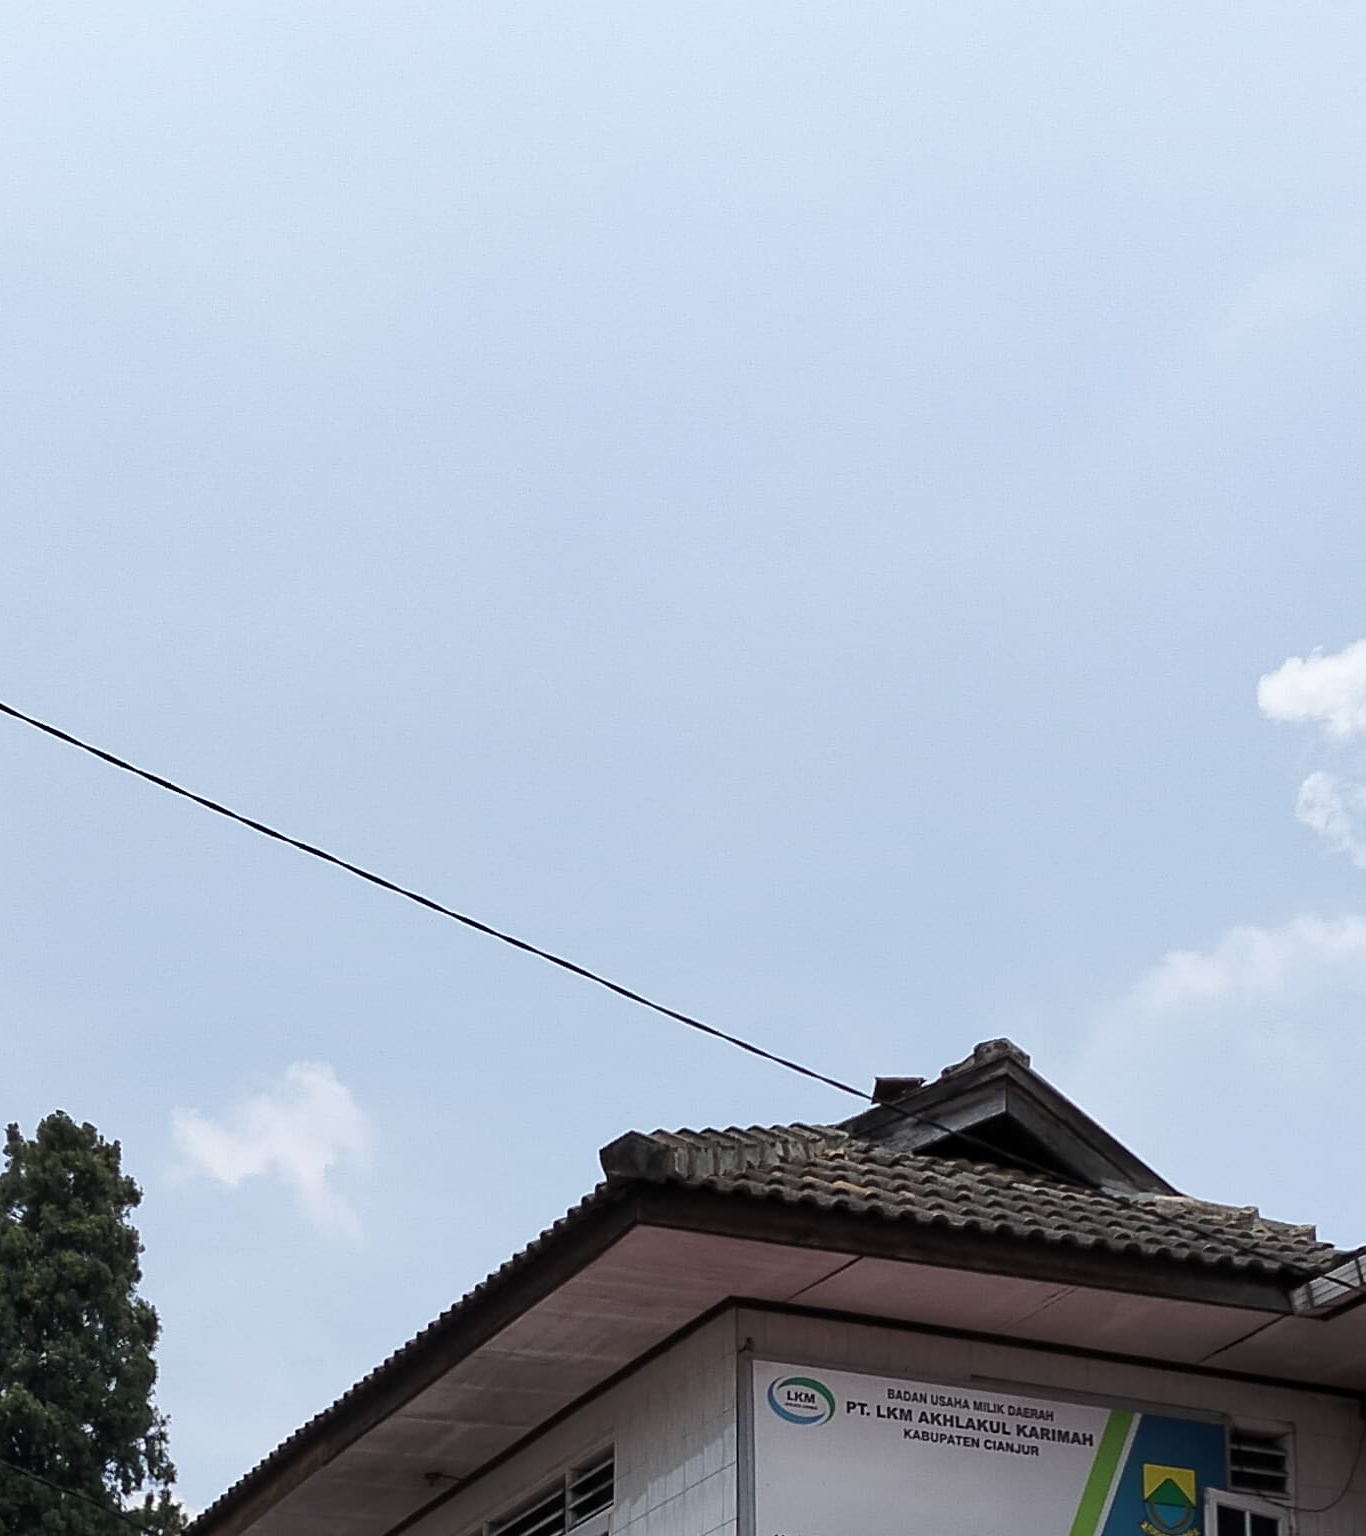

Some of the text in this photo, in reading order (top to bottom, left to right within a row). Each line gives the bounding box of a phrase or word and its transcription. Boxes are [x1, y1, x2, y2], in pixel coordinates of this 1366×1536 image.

[787, 1390, 816, 1404] LKM
[887, 1388, 1054, 1421] BADAN USAHA MILIK DAERAH
[846, 1401, 1094, 1447] PT. LKM AKHLAKUL KARIMAH
[903, 1428, 1039, 1457] KABUPATEN CIANJUR
